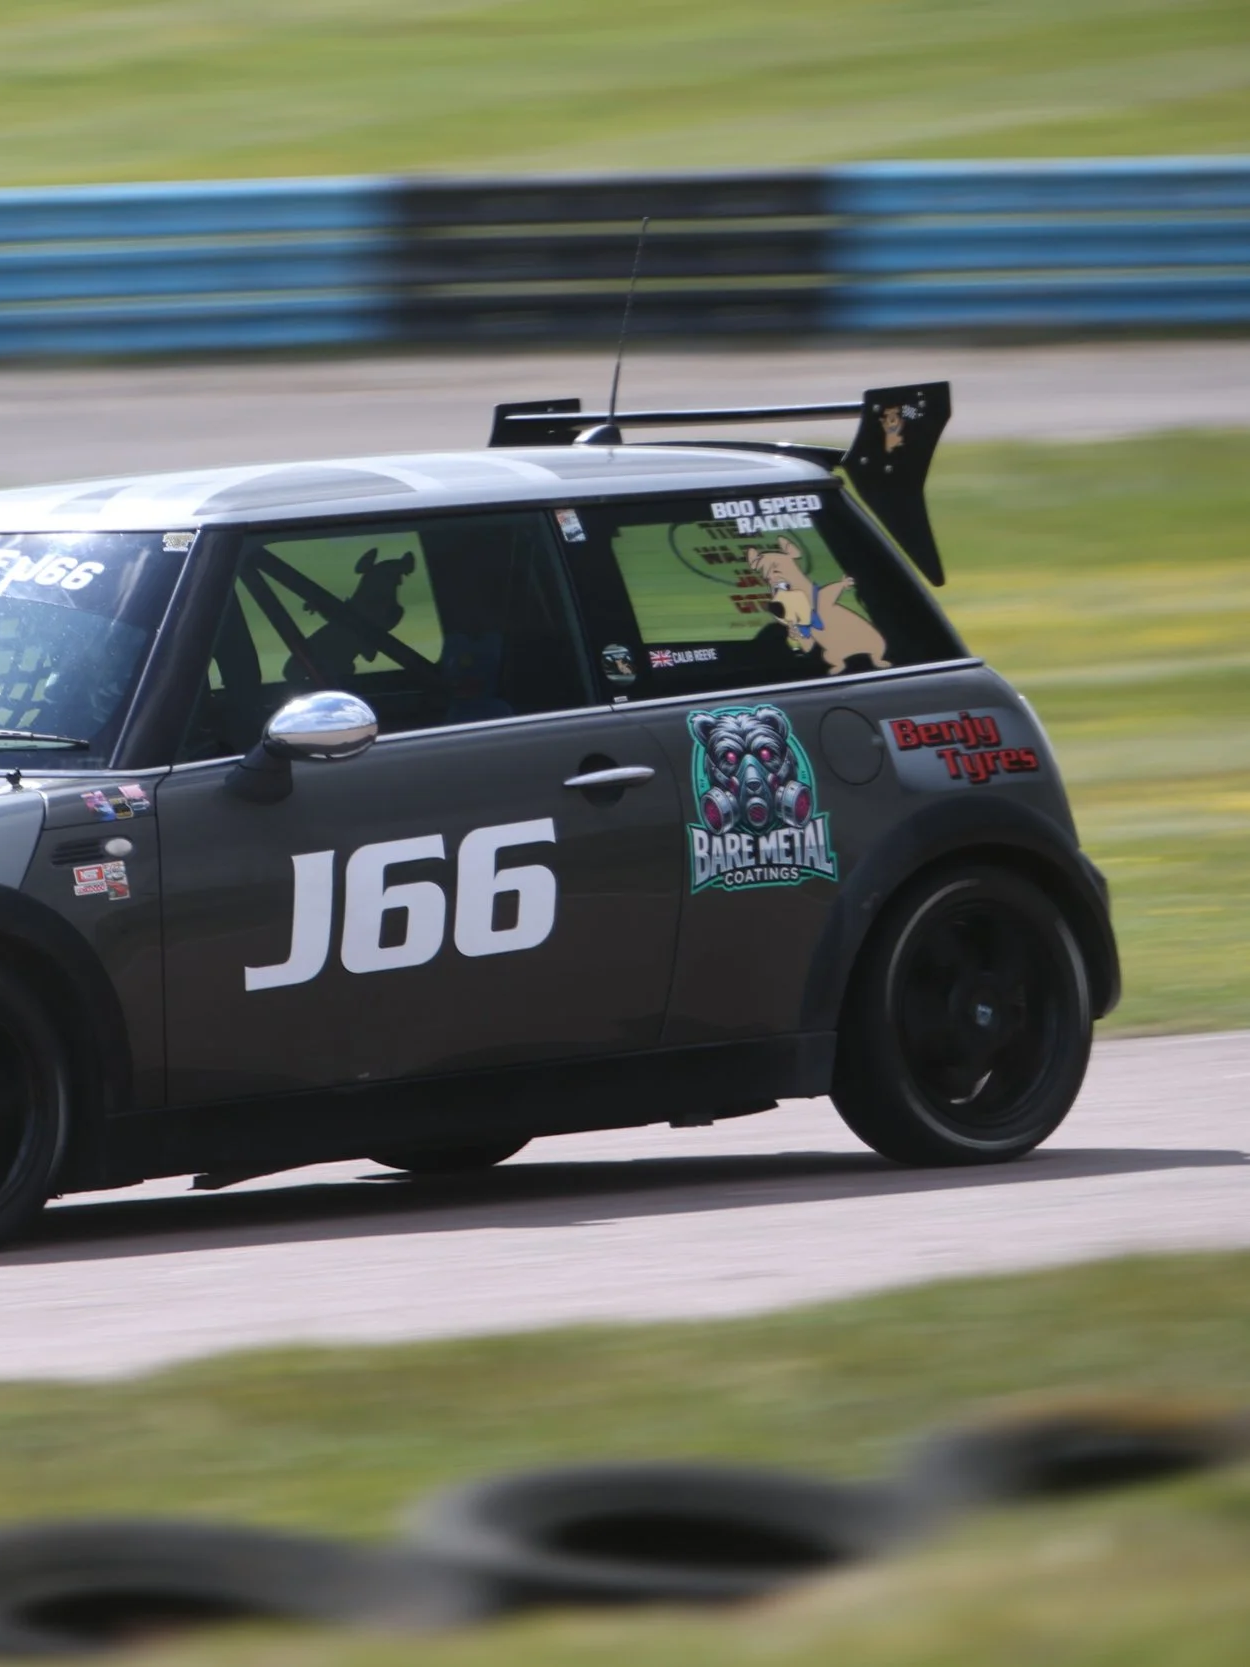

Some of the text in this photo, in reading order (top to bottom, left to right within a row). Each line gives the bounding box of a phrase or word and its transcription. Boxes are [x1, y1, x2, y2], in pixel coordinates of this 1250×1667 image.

[711, 494, 823, 519] BOO SPEED
[736, 512, 813, 534] RACING
[889, 711, 1002, 750] Benjy
[936, 748, 1040, 785] Tyres
[691, 817, 833, 886] BARE METAL
[725, 867, 799, 886] COATINGS
[245, 817, 557, 991] J66
